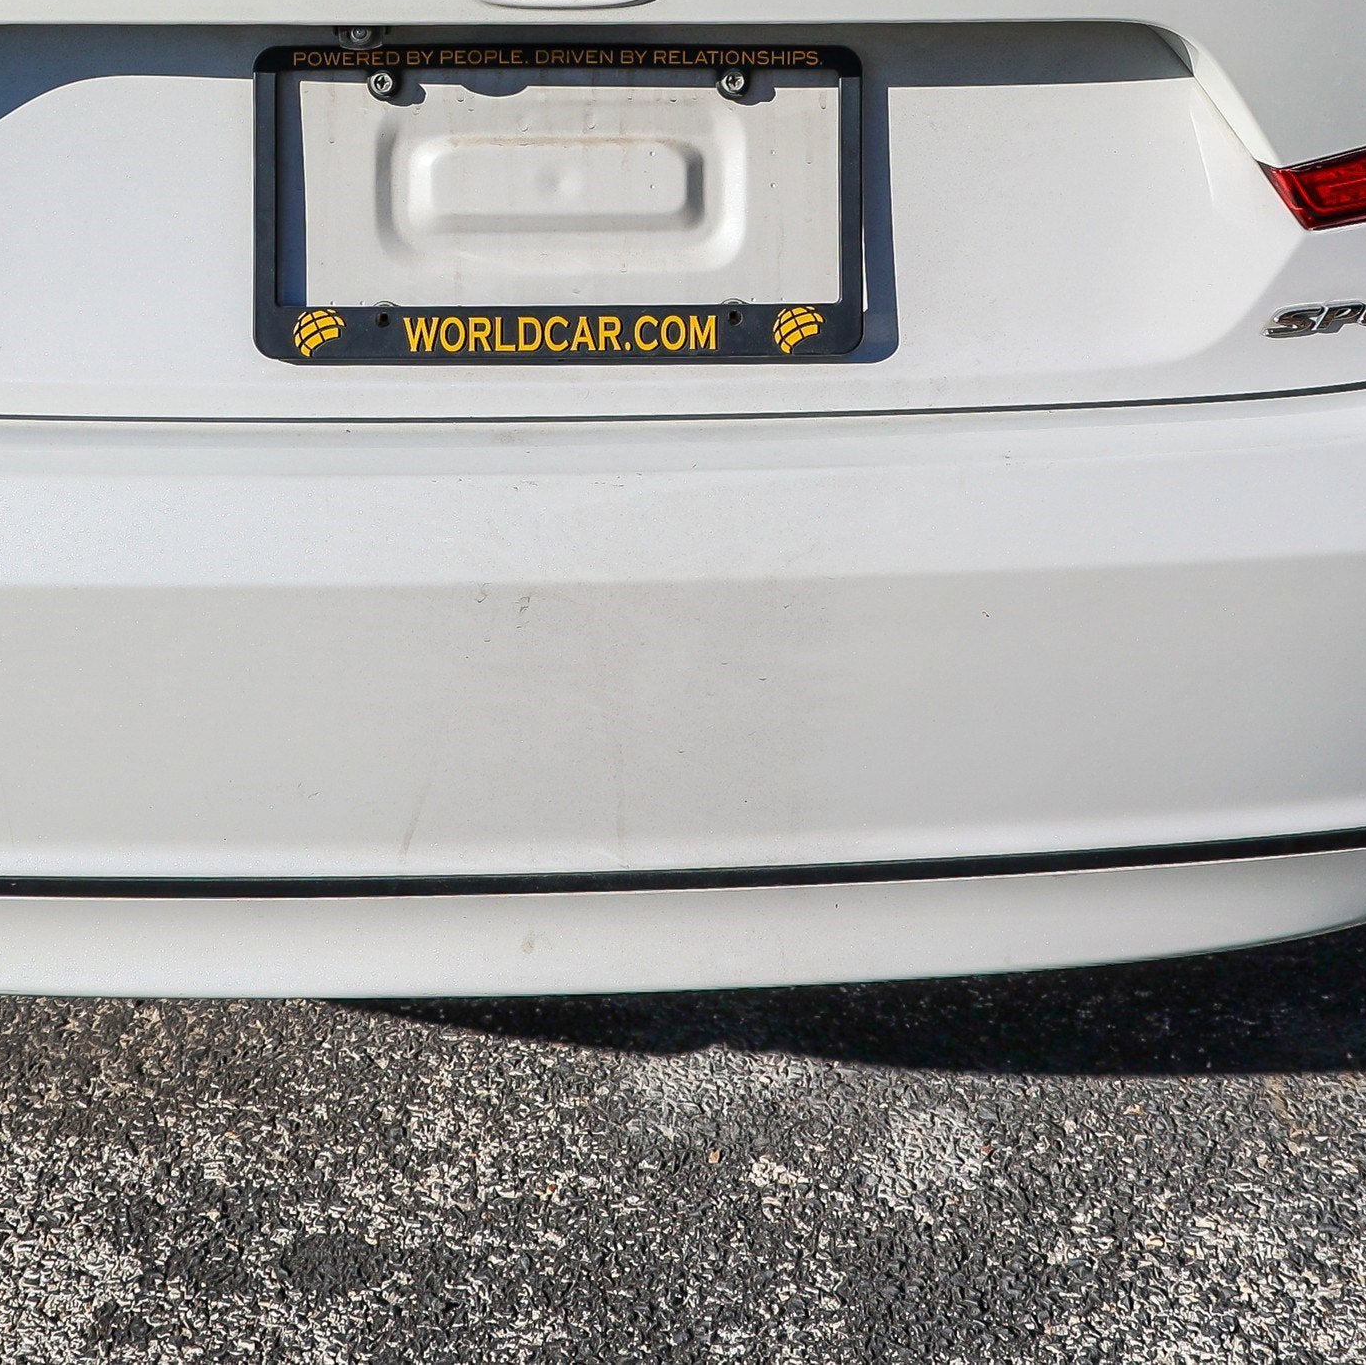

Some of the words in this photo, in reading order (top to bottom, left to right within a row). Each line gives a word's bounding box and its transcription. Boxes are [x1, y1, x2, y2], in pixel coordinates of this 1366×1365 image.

[292, 50, 400, 67] POWERED
[405, 50, 435, 66] BY
[439, 49, 530, 65] PEOPLE.
[535, 49, 614, 65] DRIVEN
[620, 49, 647, 65] BY
[653, 49, 824, 66] RELATIONSHIPS.
[402, 315, 717, 353] WORLDCAR.COM
